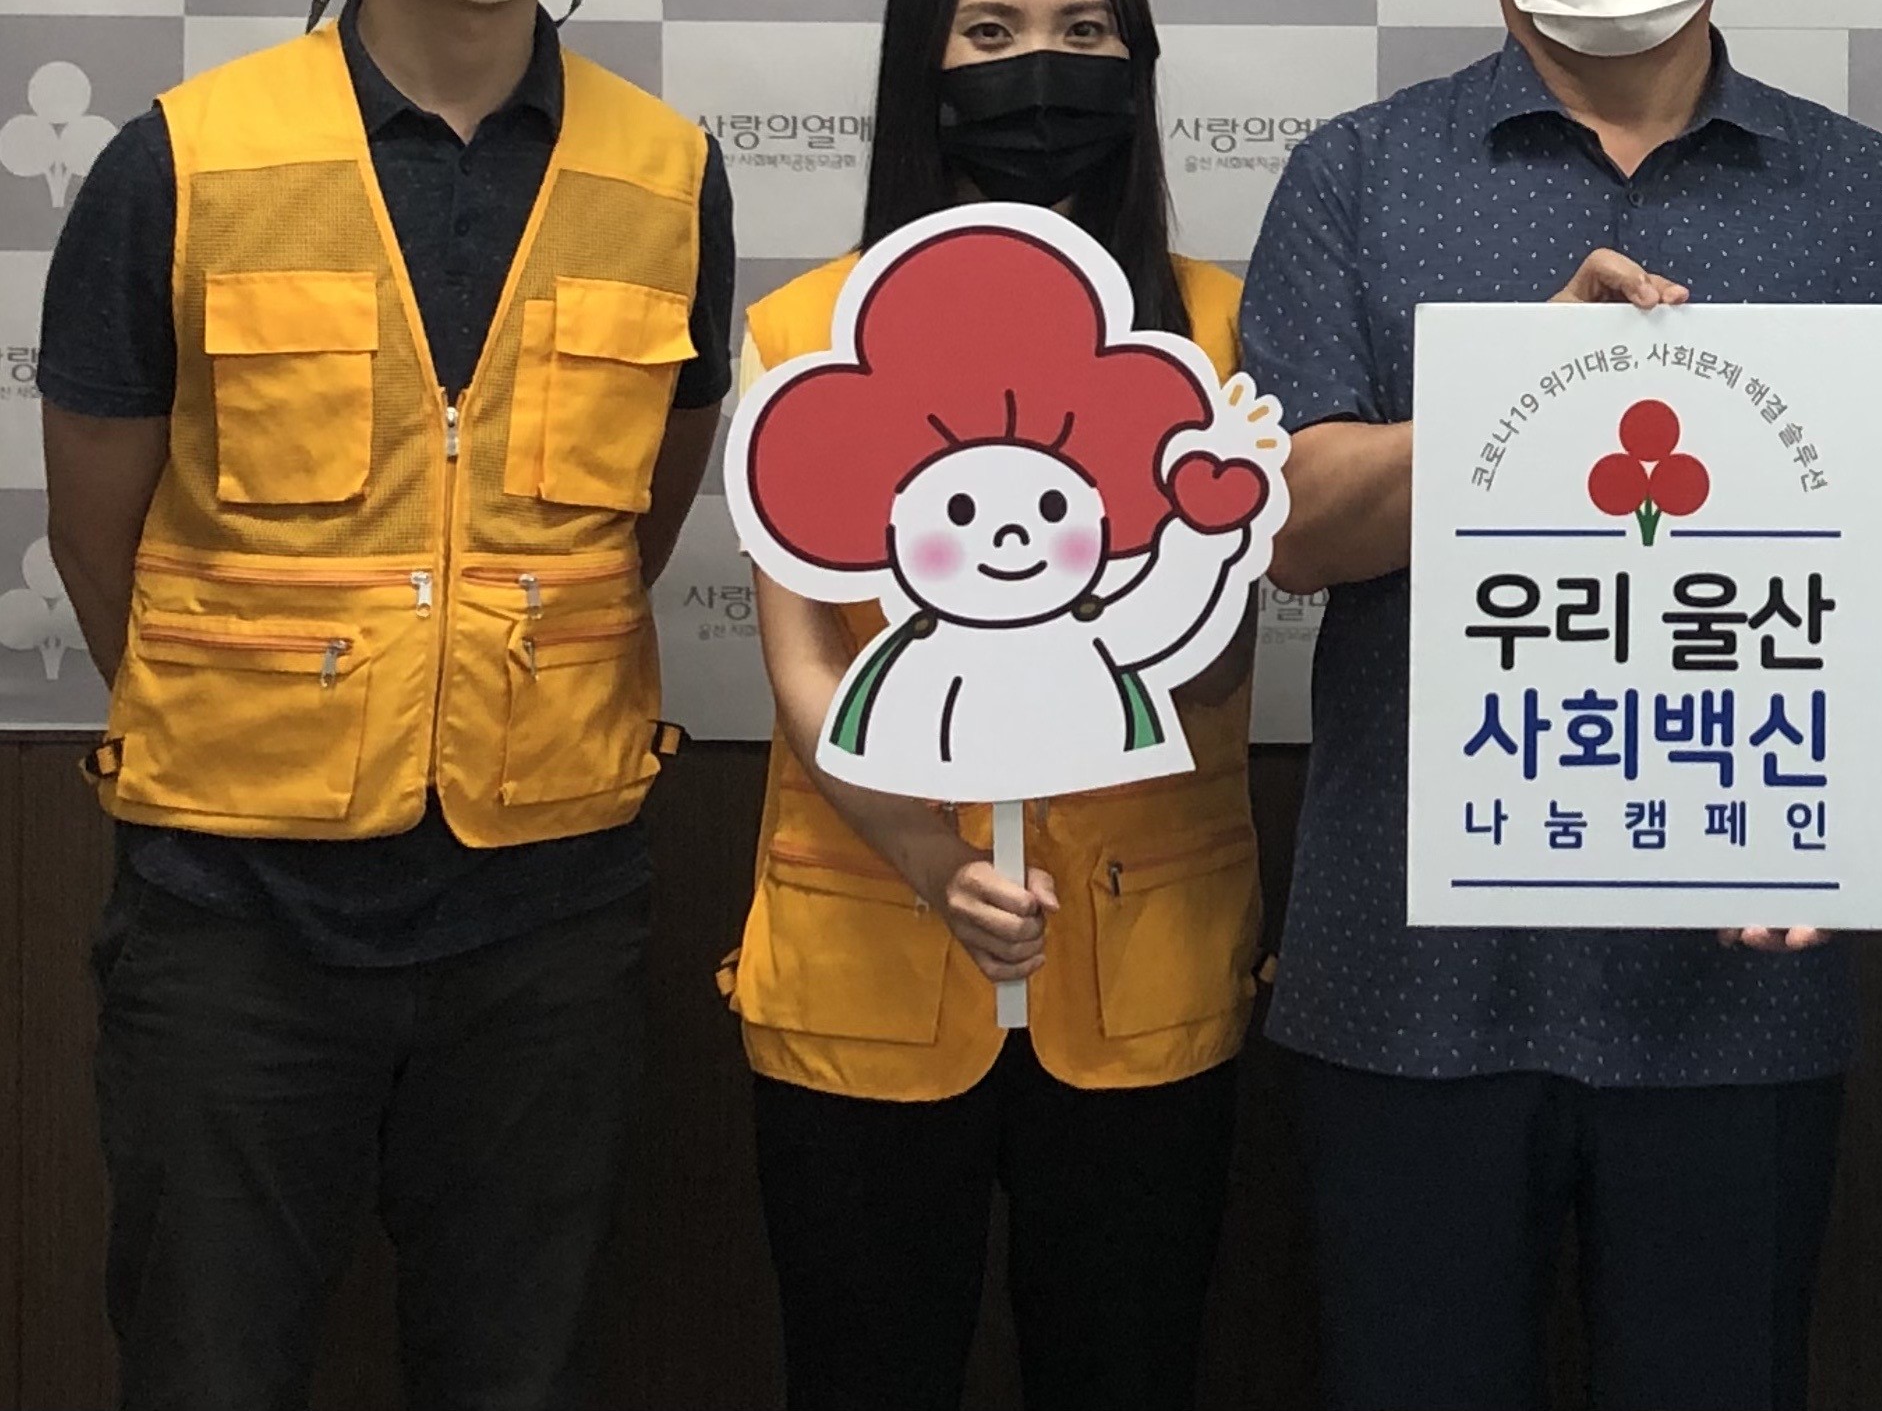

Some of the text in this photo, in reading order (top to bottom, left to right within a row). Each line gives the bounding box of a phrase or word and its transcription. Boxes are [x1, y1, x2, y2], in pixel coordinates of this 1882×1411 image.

[1170, 117, 1329, 154] 사랑의열
[1471, 343, 1829, 493] 코로나19 위기대응, 사회문제 해결 솔루션
[1465, 571, 1836, 671] 우리 울산
[1463, 688, 1828, 788] 사회백신
